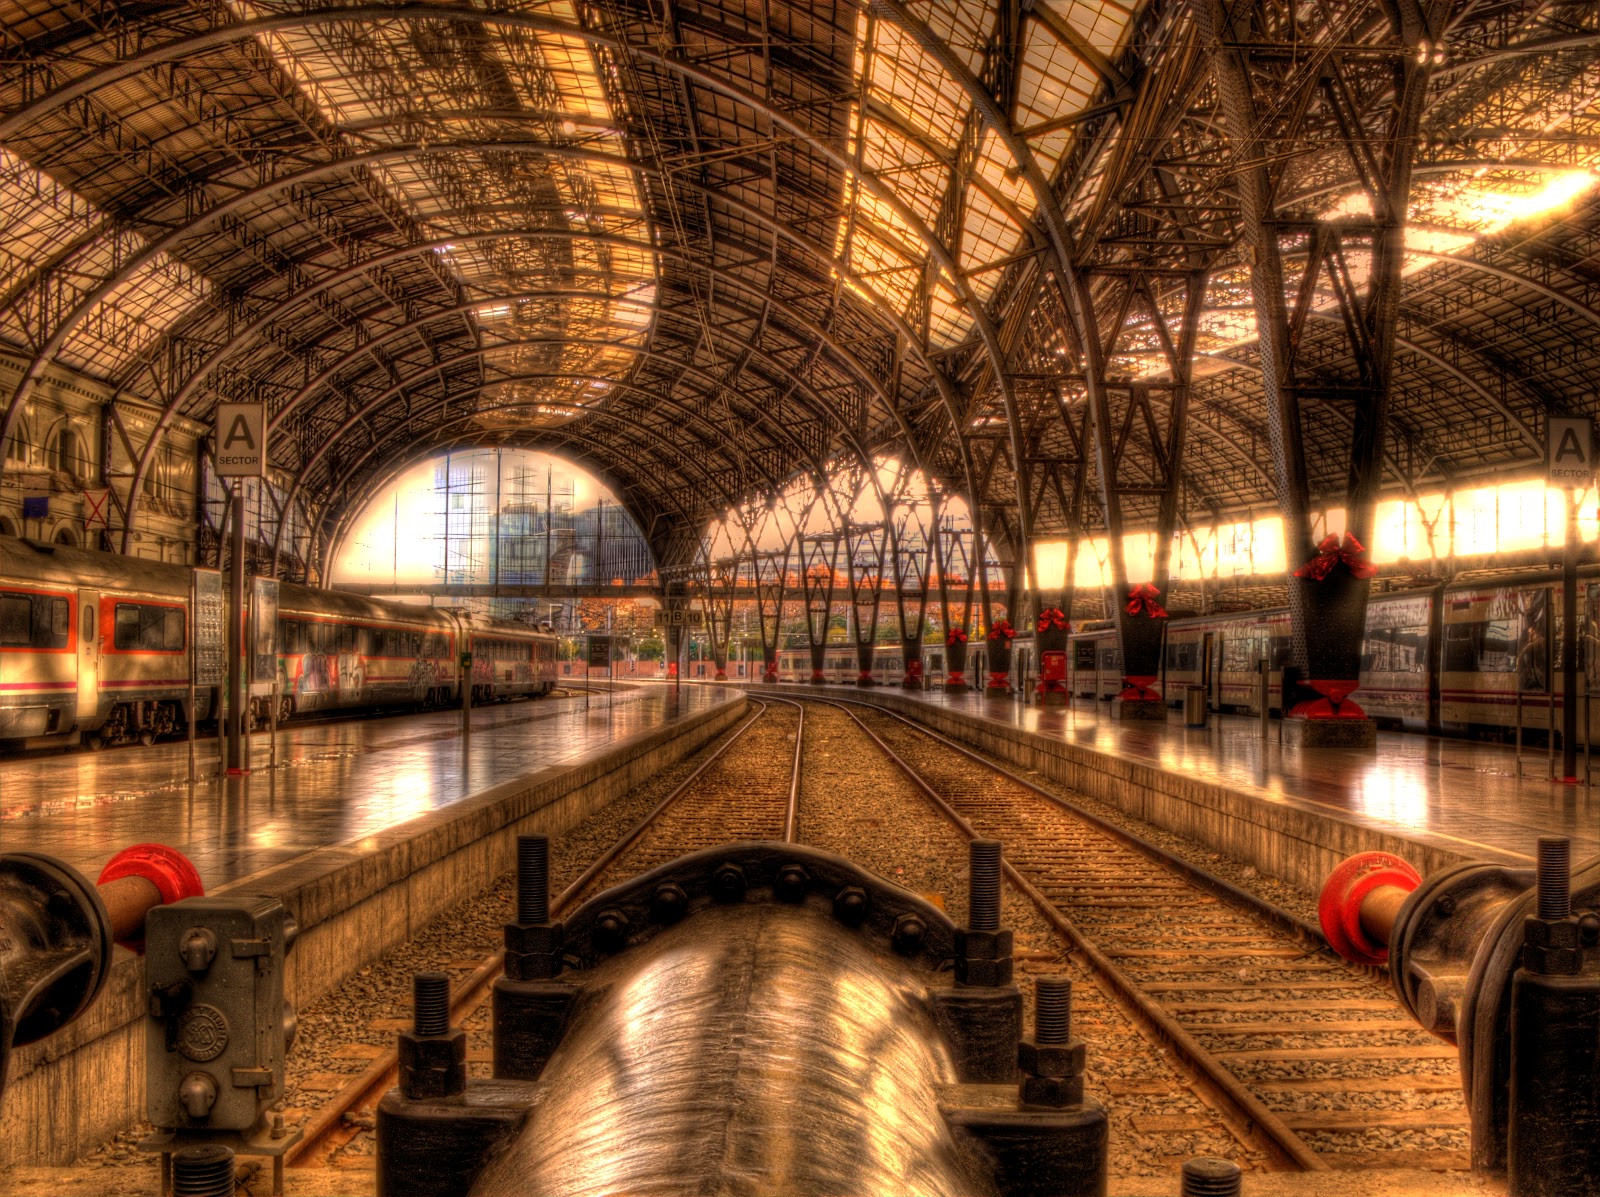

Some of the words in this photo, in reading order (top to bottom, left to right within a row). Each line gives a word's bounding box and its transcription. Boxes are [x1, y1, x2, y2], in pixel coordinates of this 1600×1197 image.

[223, 413, 255, 450] A
[1554, 427, 1586, 463] A
[219, 456, 258, 465] SECTOR
[1551, 469, 1589, 478] SECTOR
[657, 612, 669, 622] 11
[674, 611, 682, 621] B
[686, 612, 700, 622] 10
